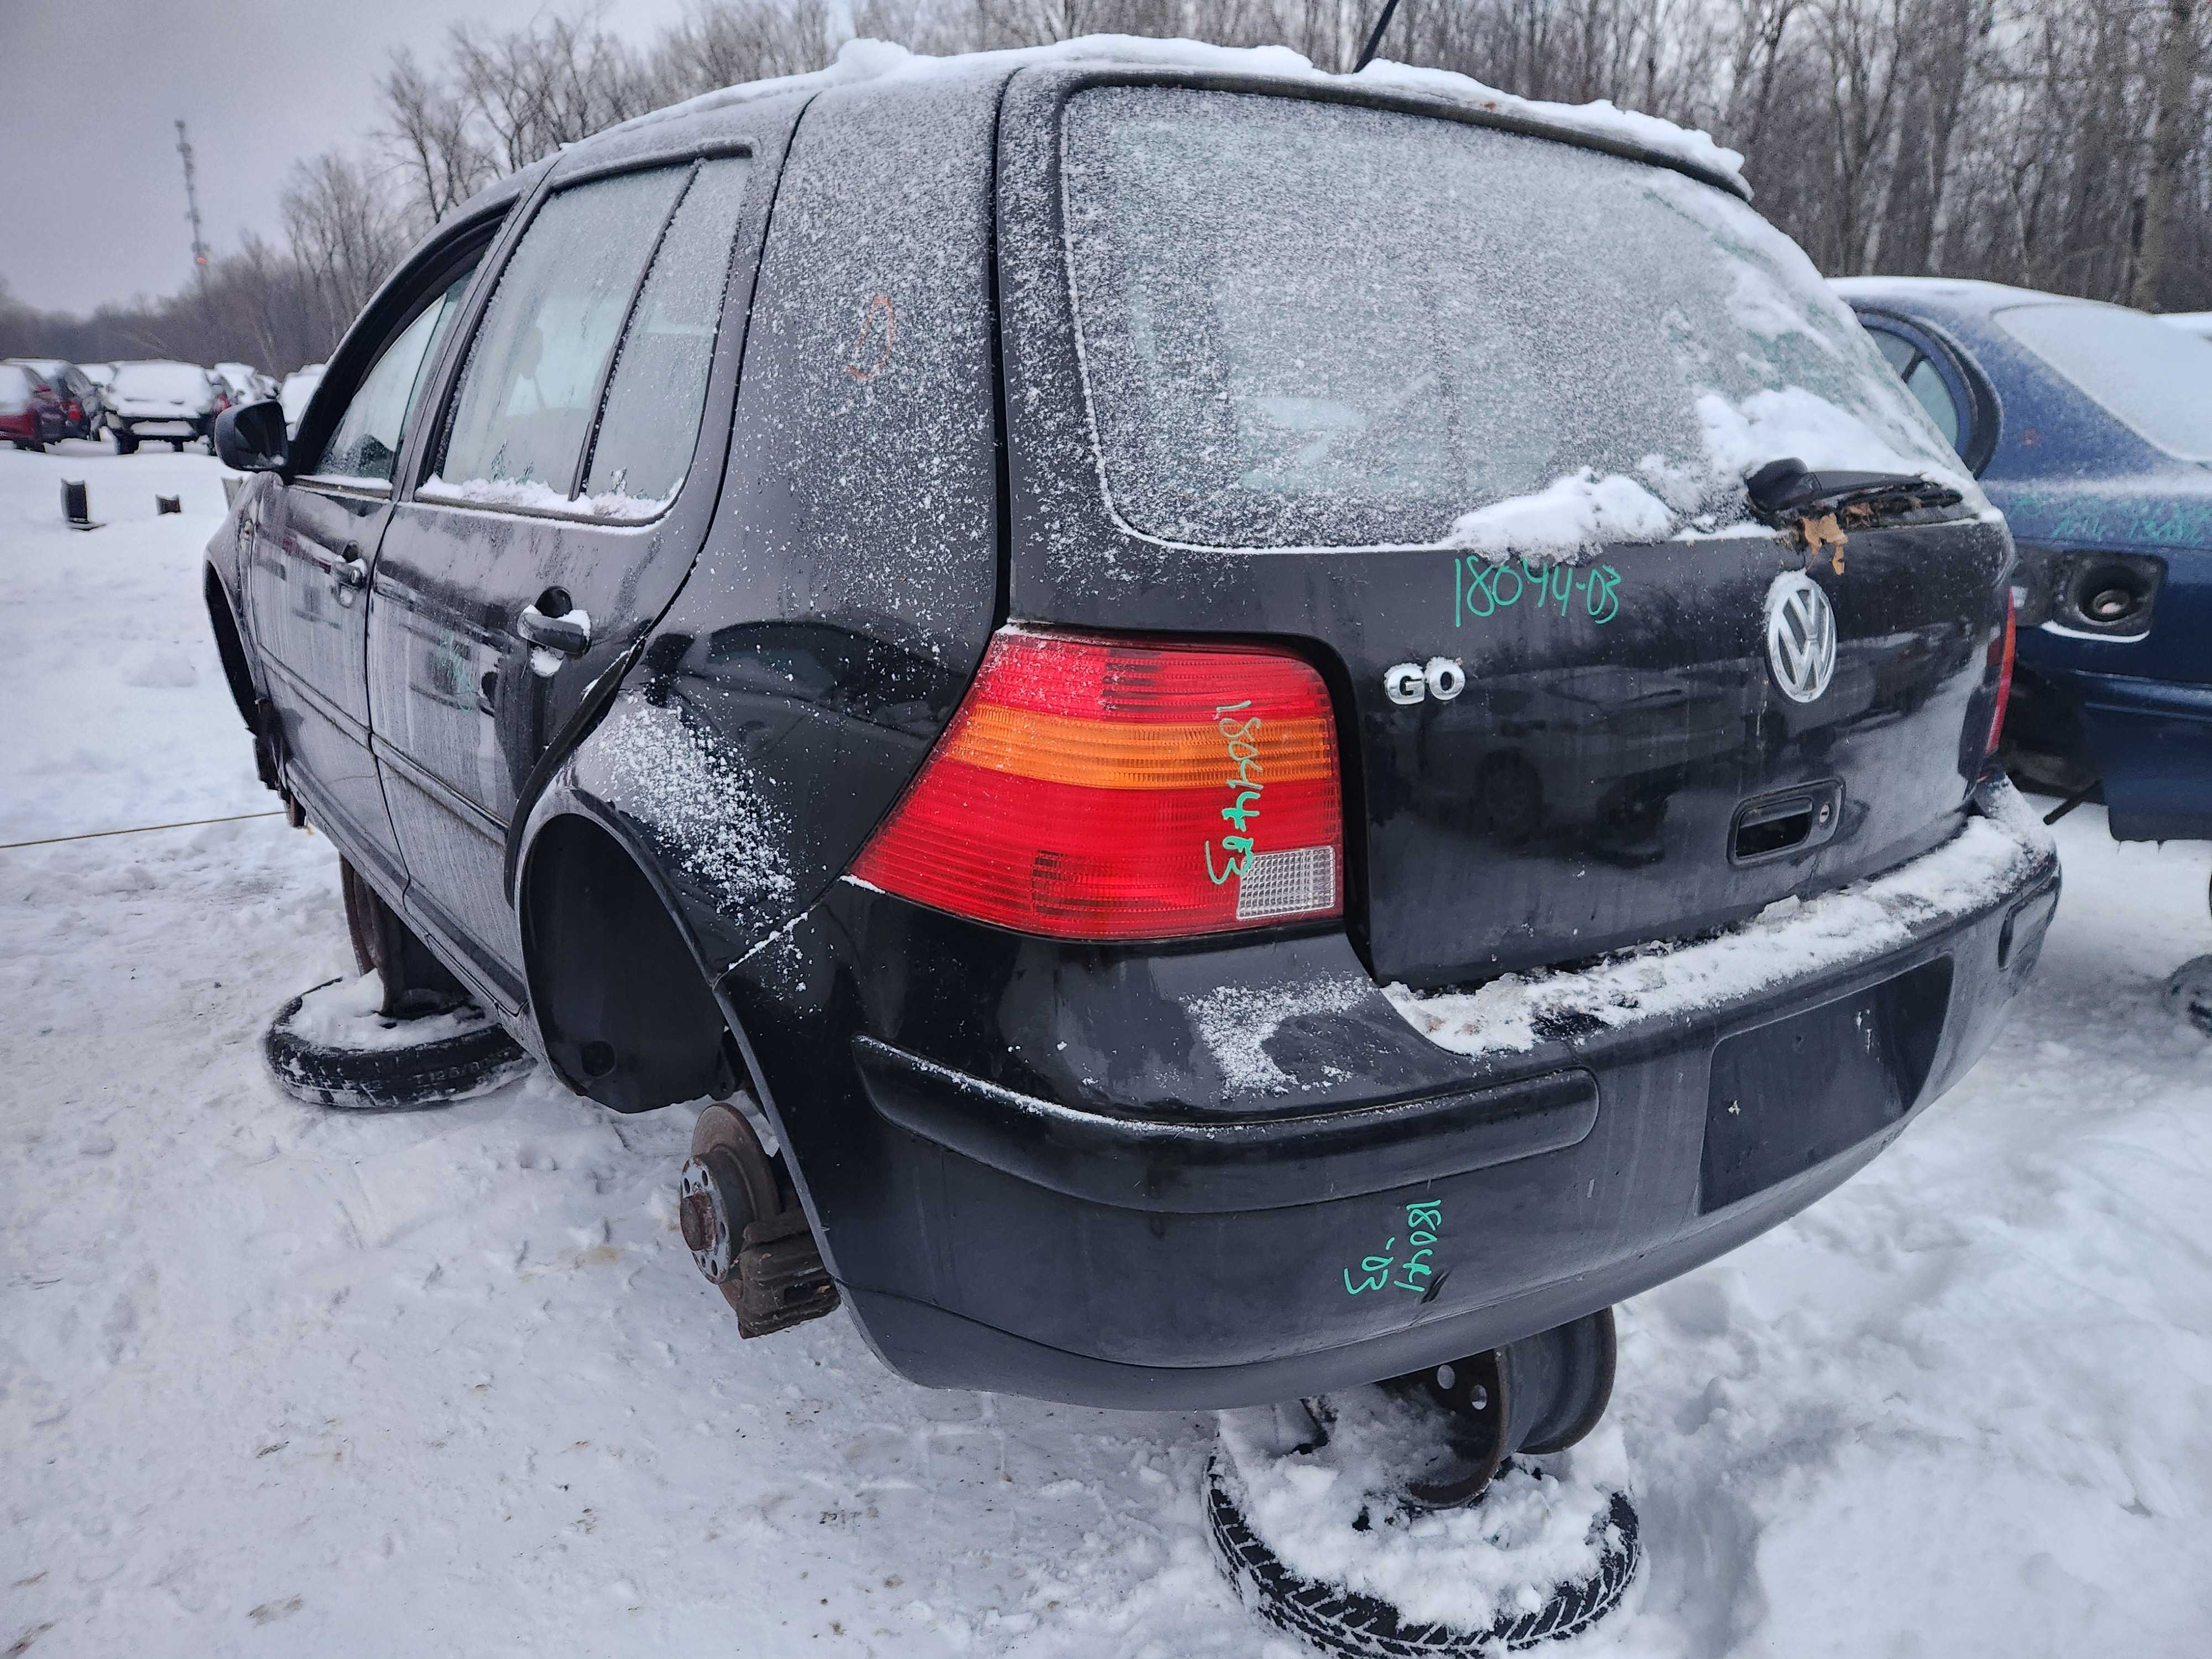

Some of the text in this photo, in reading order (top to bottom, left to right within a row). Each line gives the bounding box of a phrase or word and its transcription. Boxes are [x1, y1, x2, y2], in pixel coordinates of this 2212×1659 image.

[1455, 556, 1621, 627] 18044-03
[1767, 573, 1838, 703] VW
[1384, 657, 1466, 705] GO
